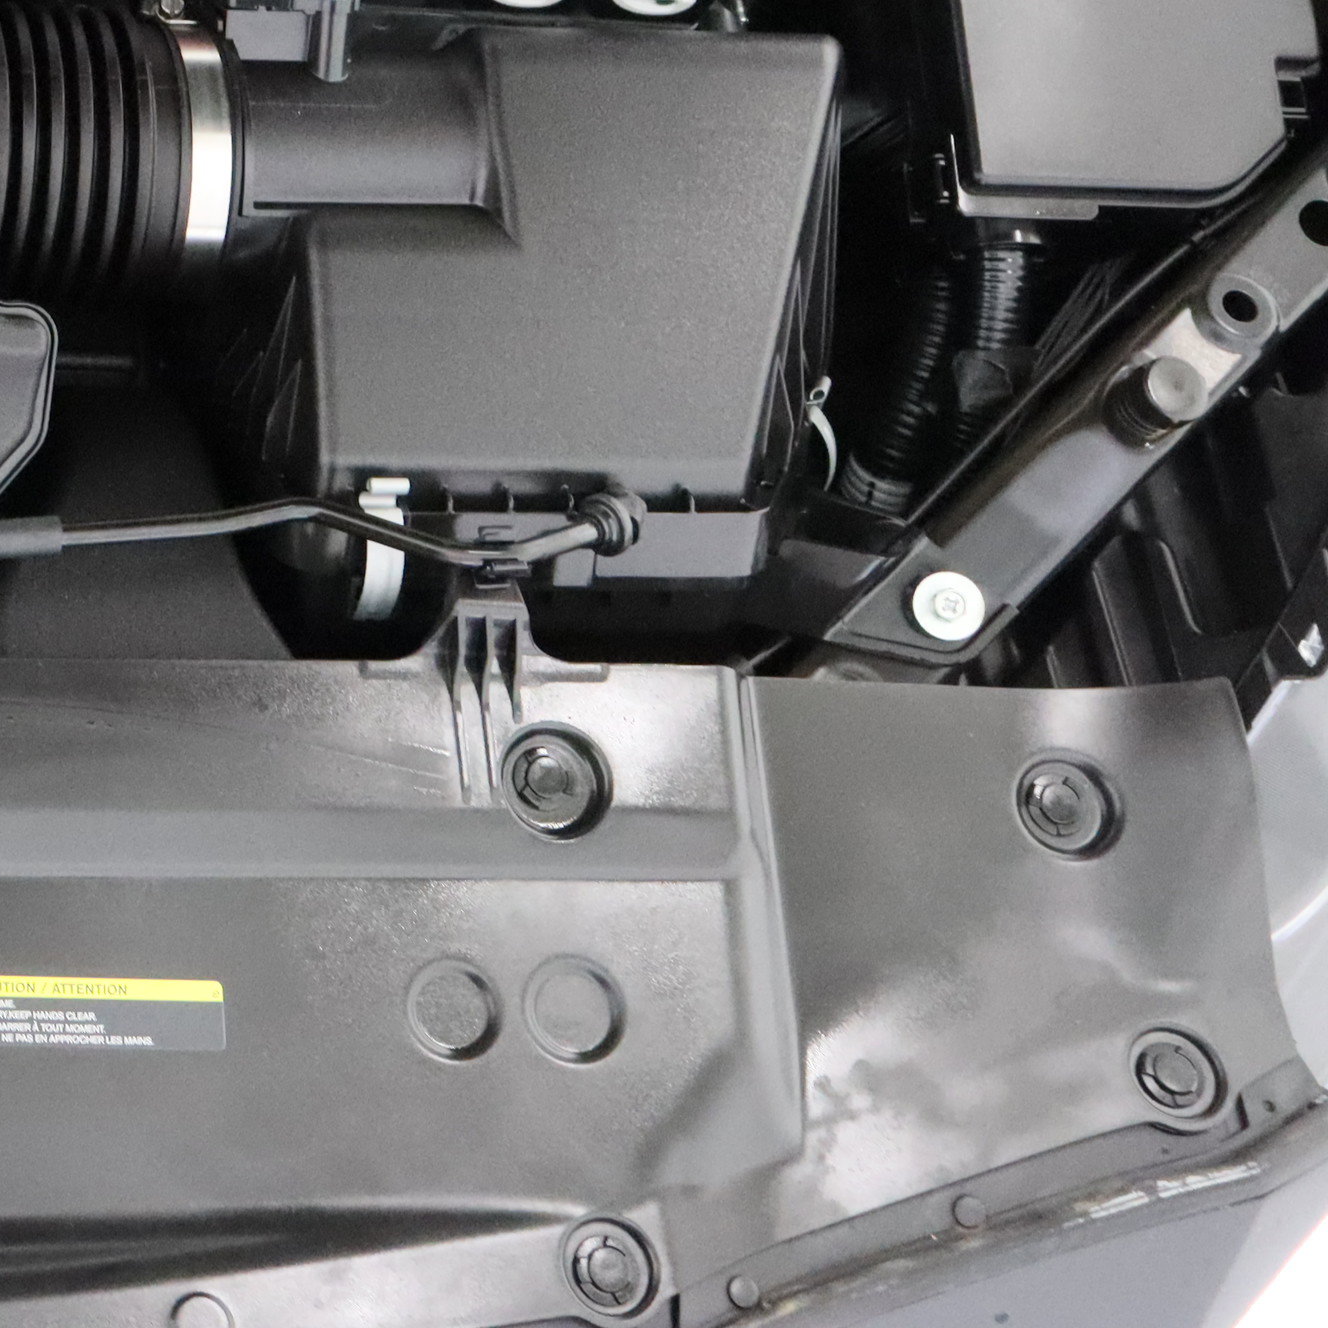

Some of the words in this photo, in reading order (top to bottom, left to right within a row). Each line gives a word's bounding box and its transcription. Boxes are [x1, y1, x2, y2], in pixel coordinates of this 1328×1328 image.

[52, 983, 128, 995] ATTENTION
[33, 1011, 65, 1020] HANDS
[40, 1023, 64, 1033] TOUT
[1, 1033, 14, 1042] NE
[15, 1034, 33, 1042] PAS
[34, 1034, 48, 1044] EN
[49, 1035, 105, 1045] APPROCHER
[106, 1036, 123, 1045] LES
